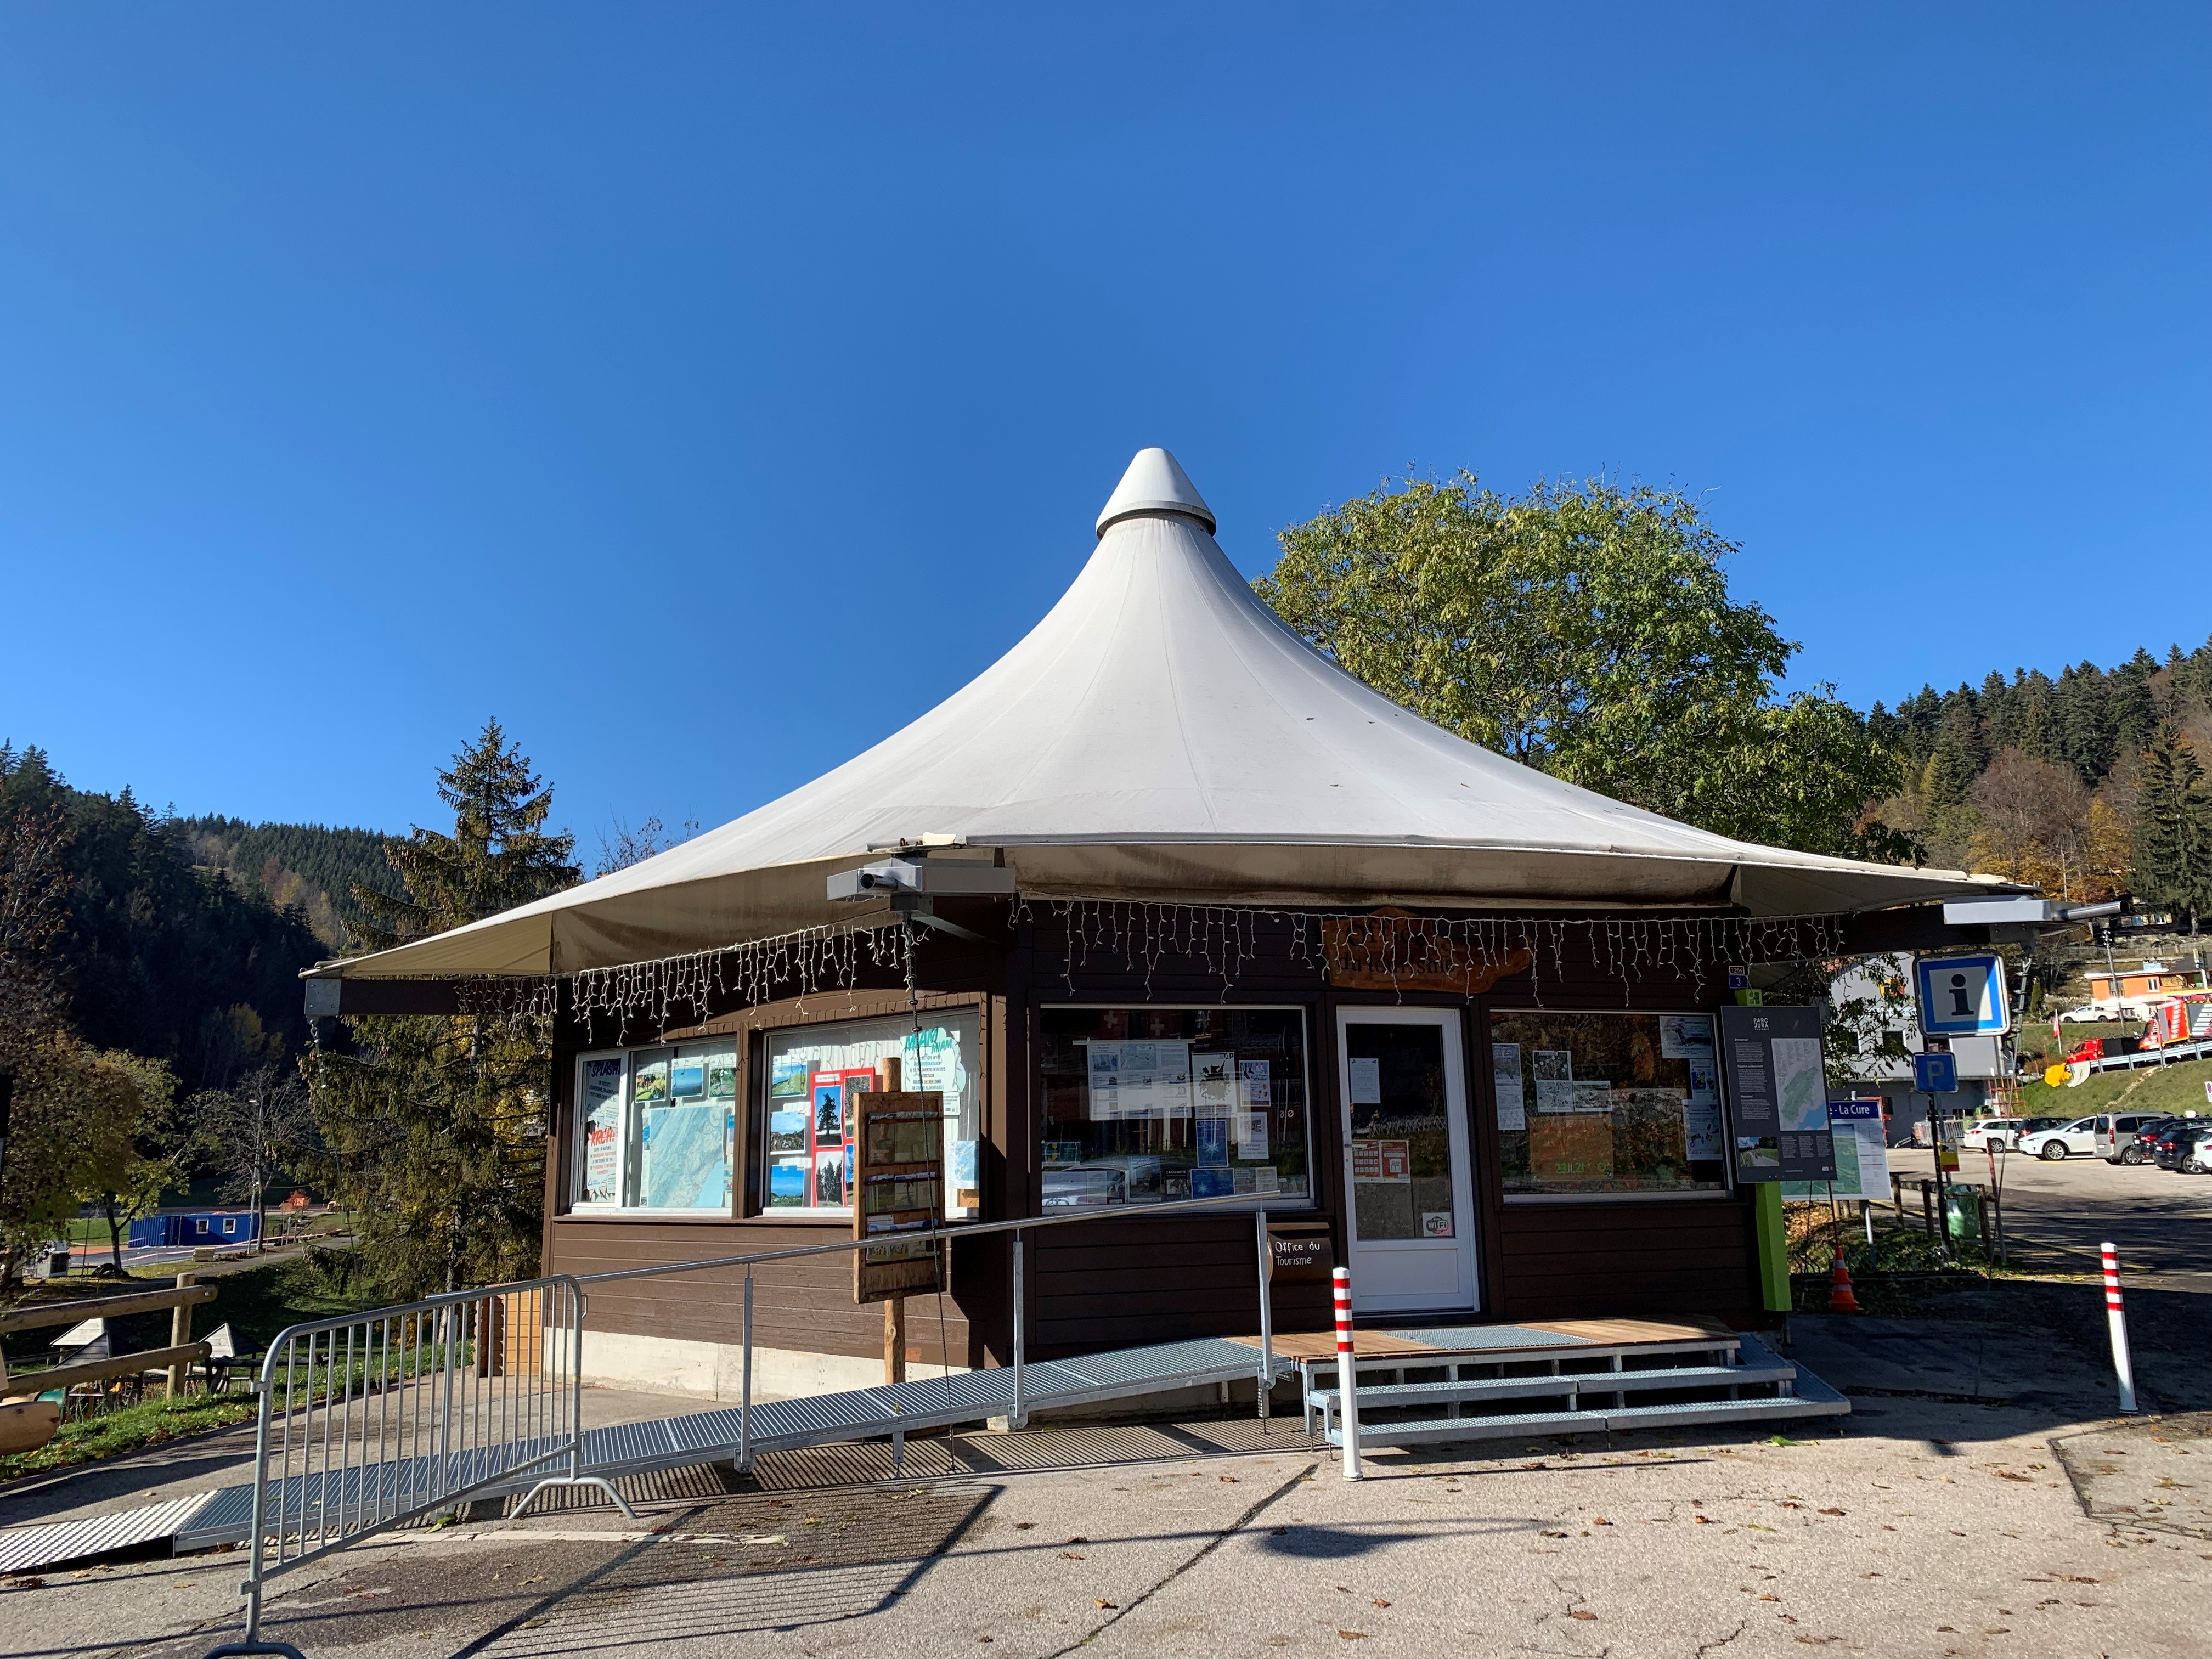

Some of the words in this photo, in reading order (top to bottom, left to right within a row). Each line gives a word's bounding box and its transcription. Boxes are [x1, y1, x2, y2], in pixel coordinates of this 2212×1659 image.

[1339, 952, 1362, 972] du
[905, 1027, 939, 1053] MAM
[931, 1038, 952, 1054] MIAM
[1926, 1061, 1945, 1087] P
[1839, 1104, 1849, 1114] La
[1850, 1104, 1870, 1114] Cure
[1275, 1242, 1304, 1253] Office
[1309, 1241, 1321, 1251] du
[1276, 1255, 1312, 1266] Tourisme
